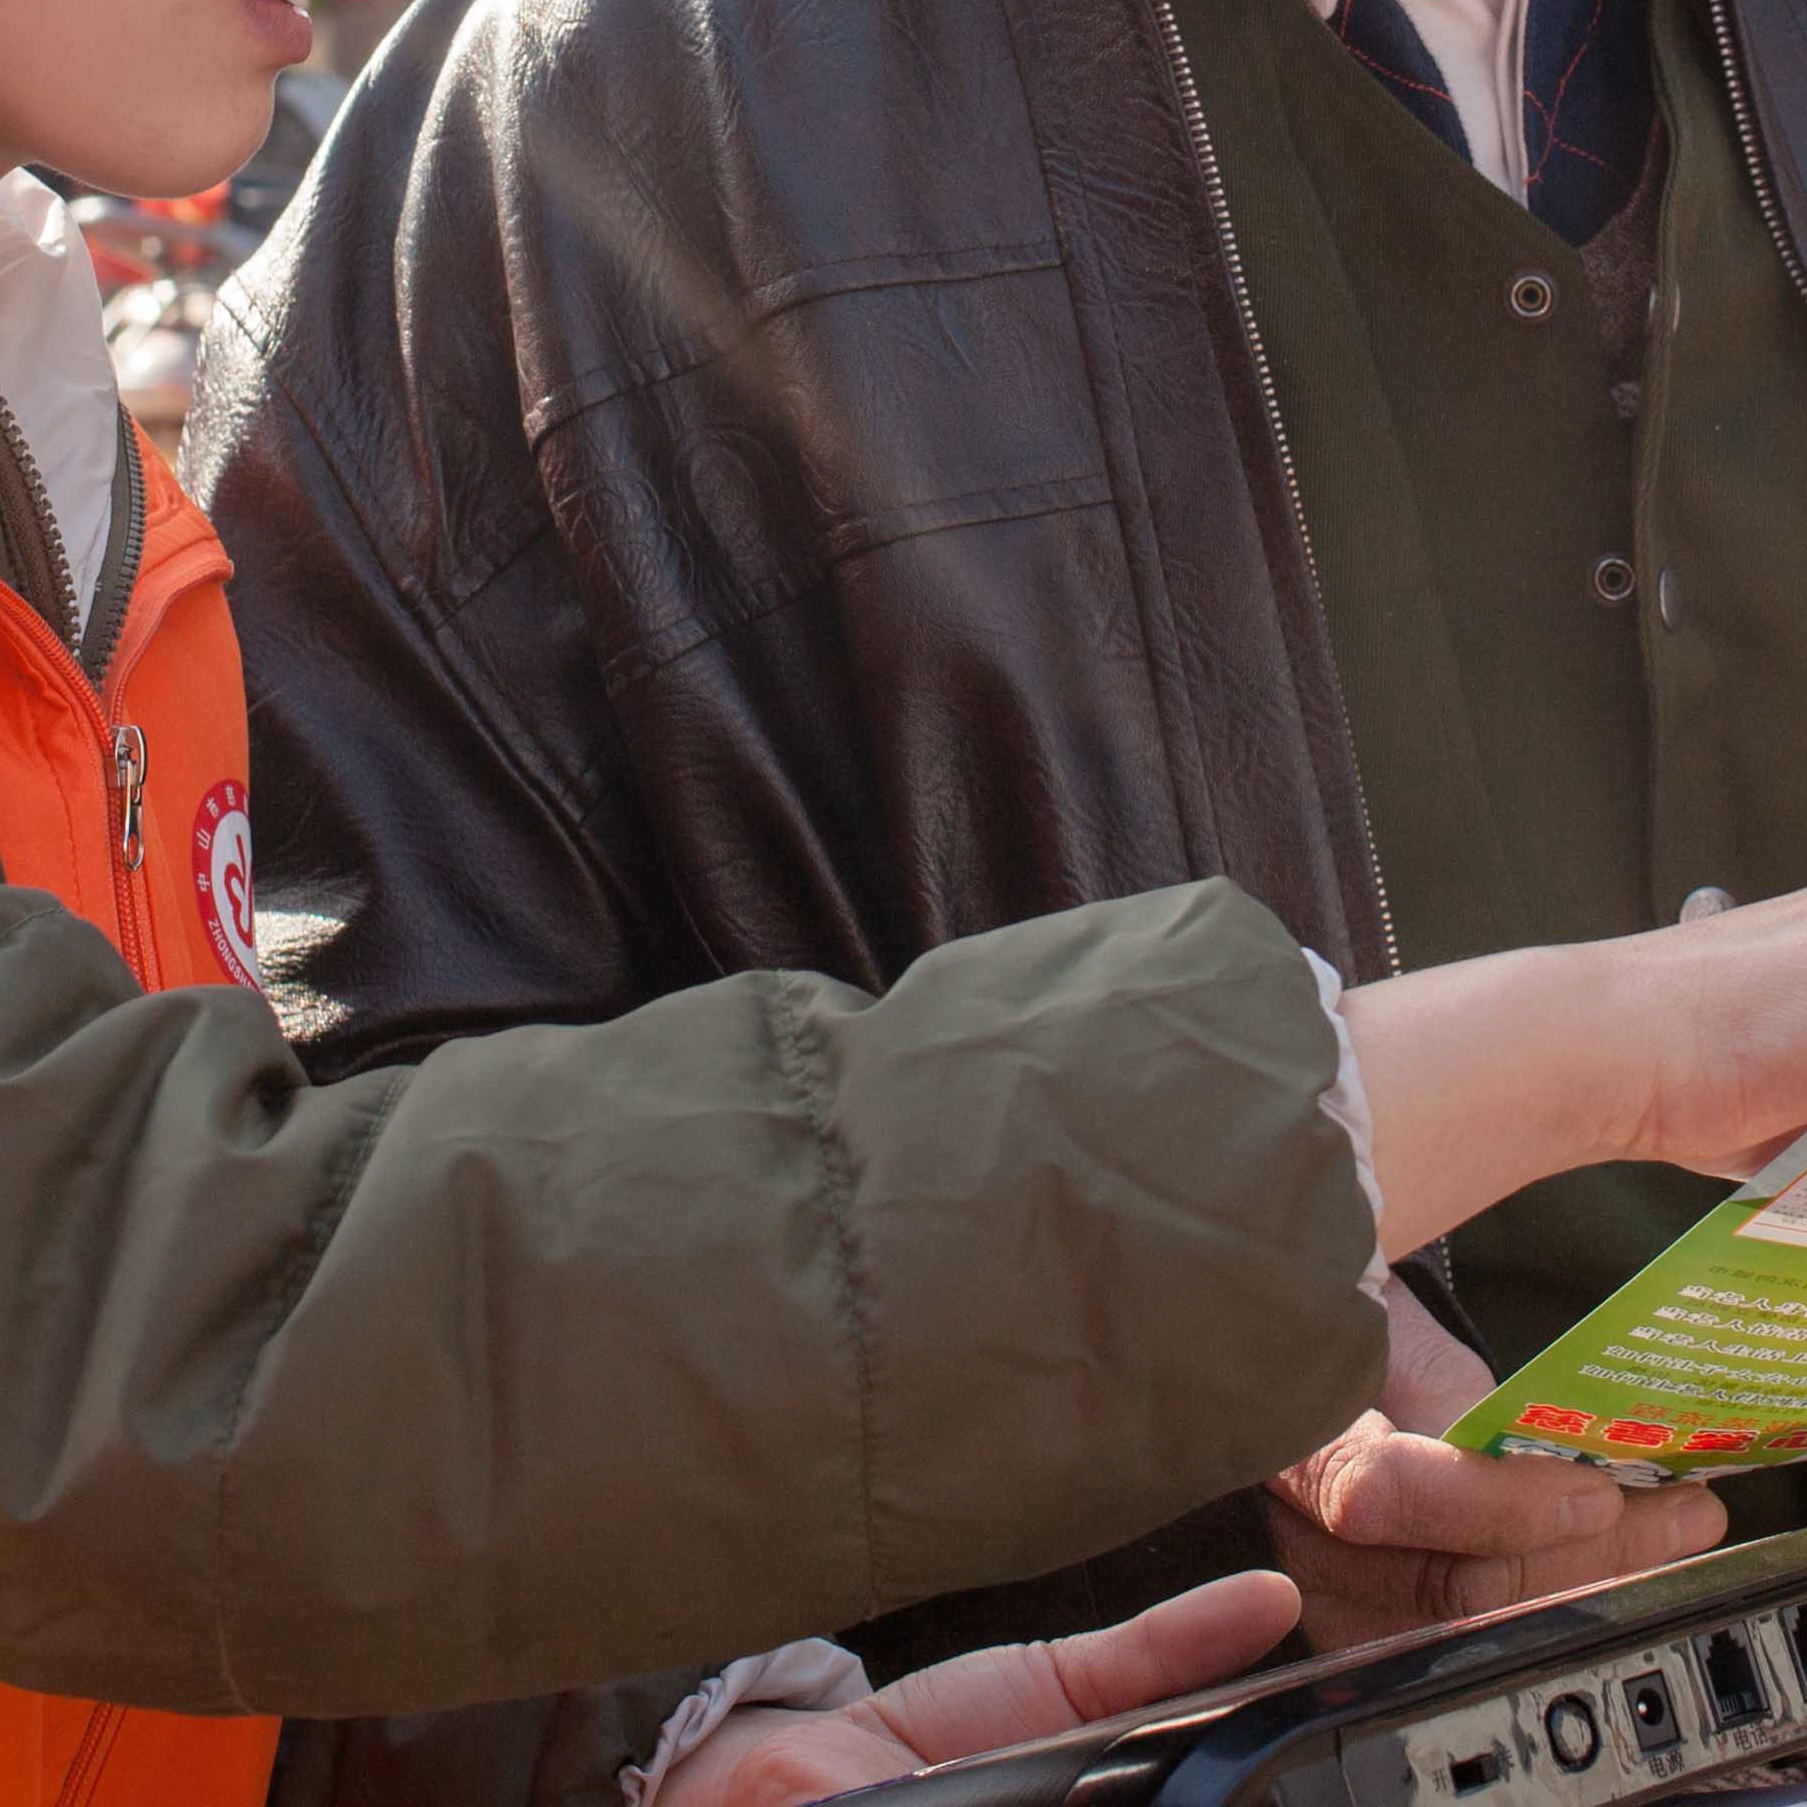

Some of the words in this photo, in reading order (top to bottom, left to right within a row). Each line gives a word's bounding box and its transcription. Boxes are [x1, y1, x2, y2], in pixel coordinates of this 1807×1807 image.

[1733, 1725, 1772, 1751] 电话
[1648, 1751, 1685, 1779] 电源
[1432, 1768, 1448, 1792] 开
